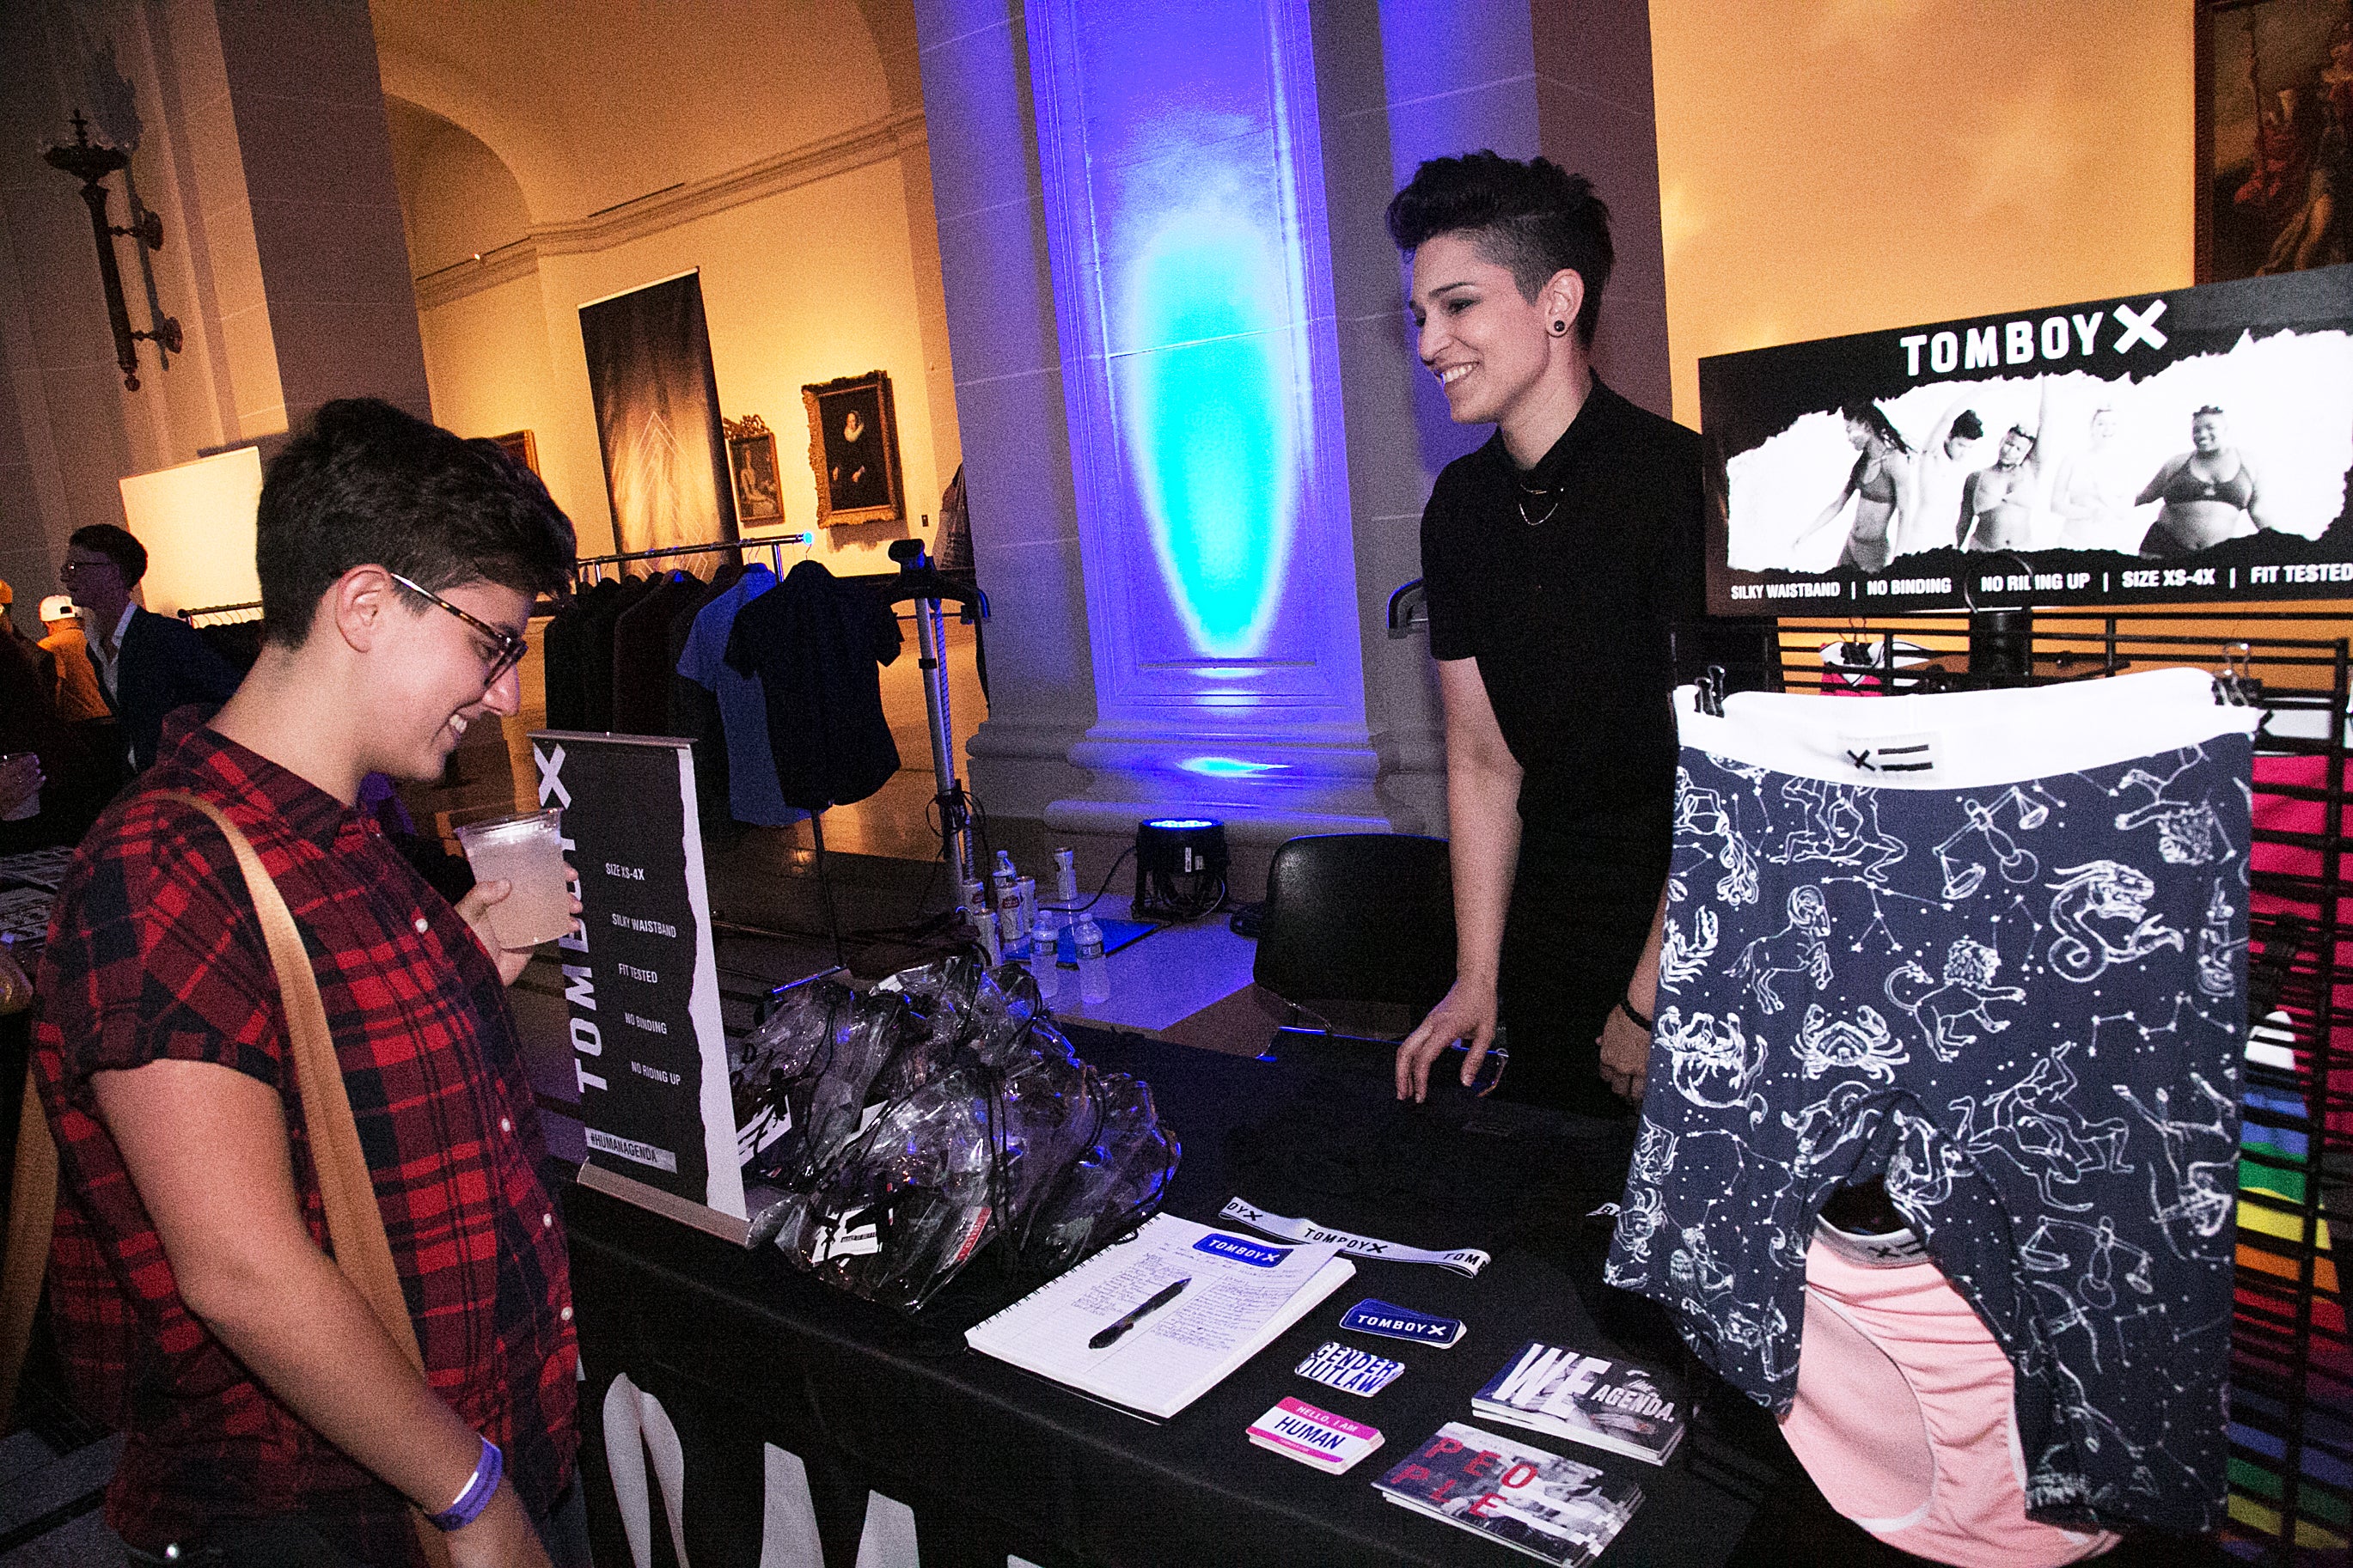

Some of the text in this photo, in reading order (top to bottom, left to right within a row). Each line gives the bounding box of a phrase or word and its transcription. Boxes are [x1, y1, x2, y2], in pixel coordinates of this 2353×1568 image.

[1900, 299, 2168, 376] TOMBOYX
[1731, 584, 1763, 600] SILKY
[1766, 582, 1841, 599] WAISTBAND
[1867, 579, 1887, 595] NO
[1891, 577, 1952, 595] BINDING
[1981, 576, 2003, 592] NO
[2066, 572, 2090, 589] UP
[2122, 570, 2160, 589] SIZE
[2163, 568, 2215, 588] XS-4X
[2251, 565, 2281, 583] FIT
[2283, 563, 2353, 583] TESTED
[605, 863, 645, 881] SIZE XS-4X
[612, 913, 676, 938] SILKY WAISTBAND
[619, 963, 657, 983] FIT TESTED
[625, 1012, 668, 1034] NO BINDING
[631, 1060, 681, 1086] NO RIDING UP
[590, 1132, 657, 1162] #HUMANAGENDA
[1208, 1238, 1280, 1262] TOMBOYX
[1358, 1315, 1447, 1337] TOMBOYX
[1317, 1342, 1400, 1376] GENDER
[1299, 1357, 1384, 1393] OUTLAW
[1492, 1343, 1612, 1419] WE
[1592, 1384, 1676, 1423] AGENDA.
[1274, 1417, 1347, 1450] HUMAN
[1296, 1406, 1331, 1424] HELLO,
[1340, 1420, 1358, 1433] AM
[1425, 1436, 1538, 1489] PEO
[1391, 1463, 1508, 1519] PLE
